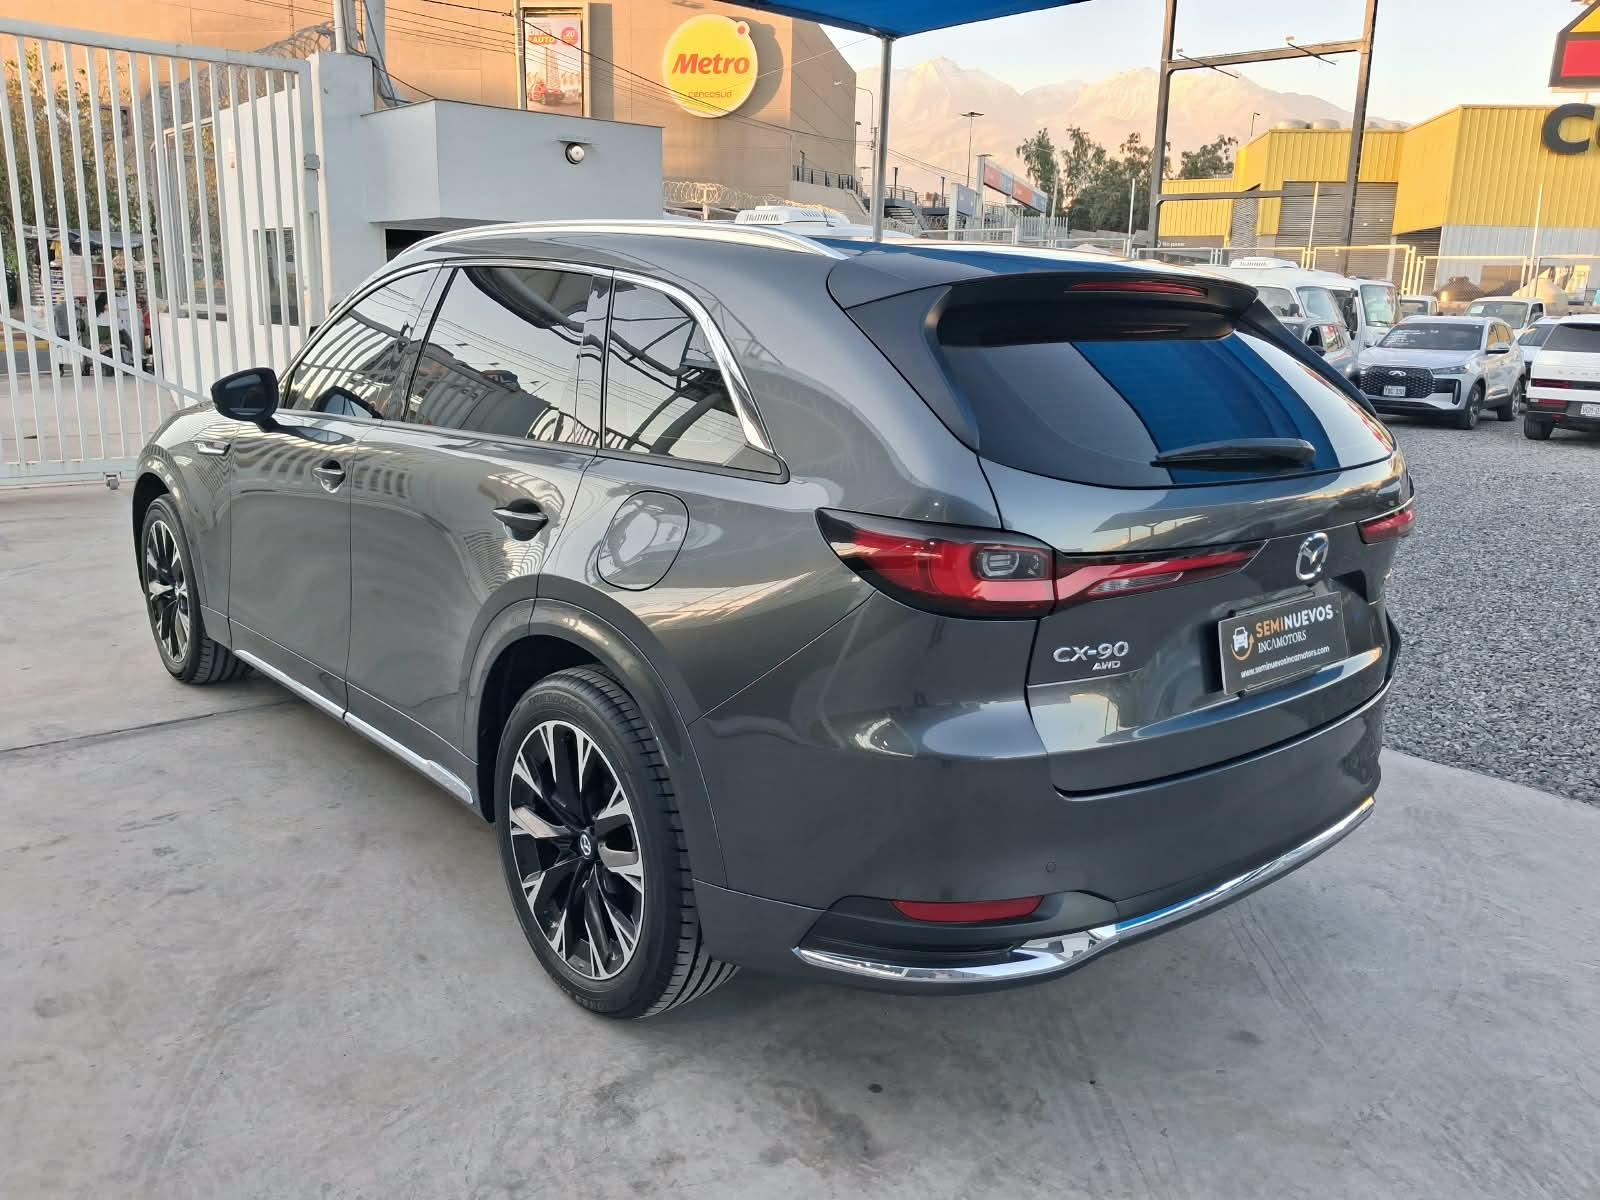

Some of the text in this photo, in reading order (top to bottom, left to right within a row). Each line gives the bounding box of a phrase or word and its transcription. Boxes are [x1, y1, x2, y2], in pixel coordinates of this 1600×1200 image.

[672, 53, 750, 74] Metro
[688, 90, 732, 98] cencosud
[1541, 103, 1600, 155] C
[1255, 604, 1334, 638] SEMINUEVOS
[1053, 641, 1129, 663] CX-90
[1258, 629, 1307, 654] INCAMOTORS
[1092, 660, 1121, 671] AWD
[1240, 645, 1331, 679] www.seminuevosincamotors.com
